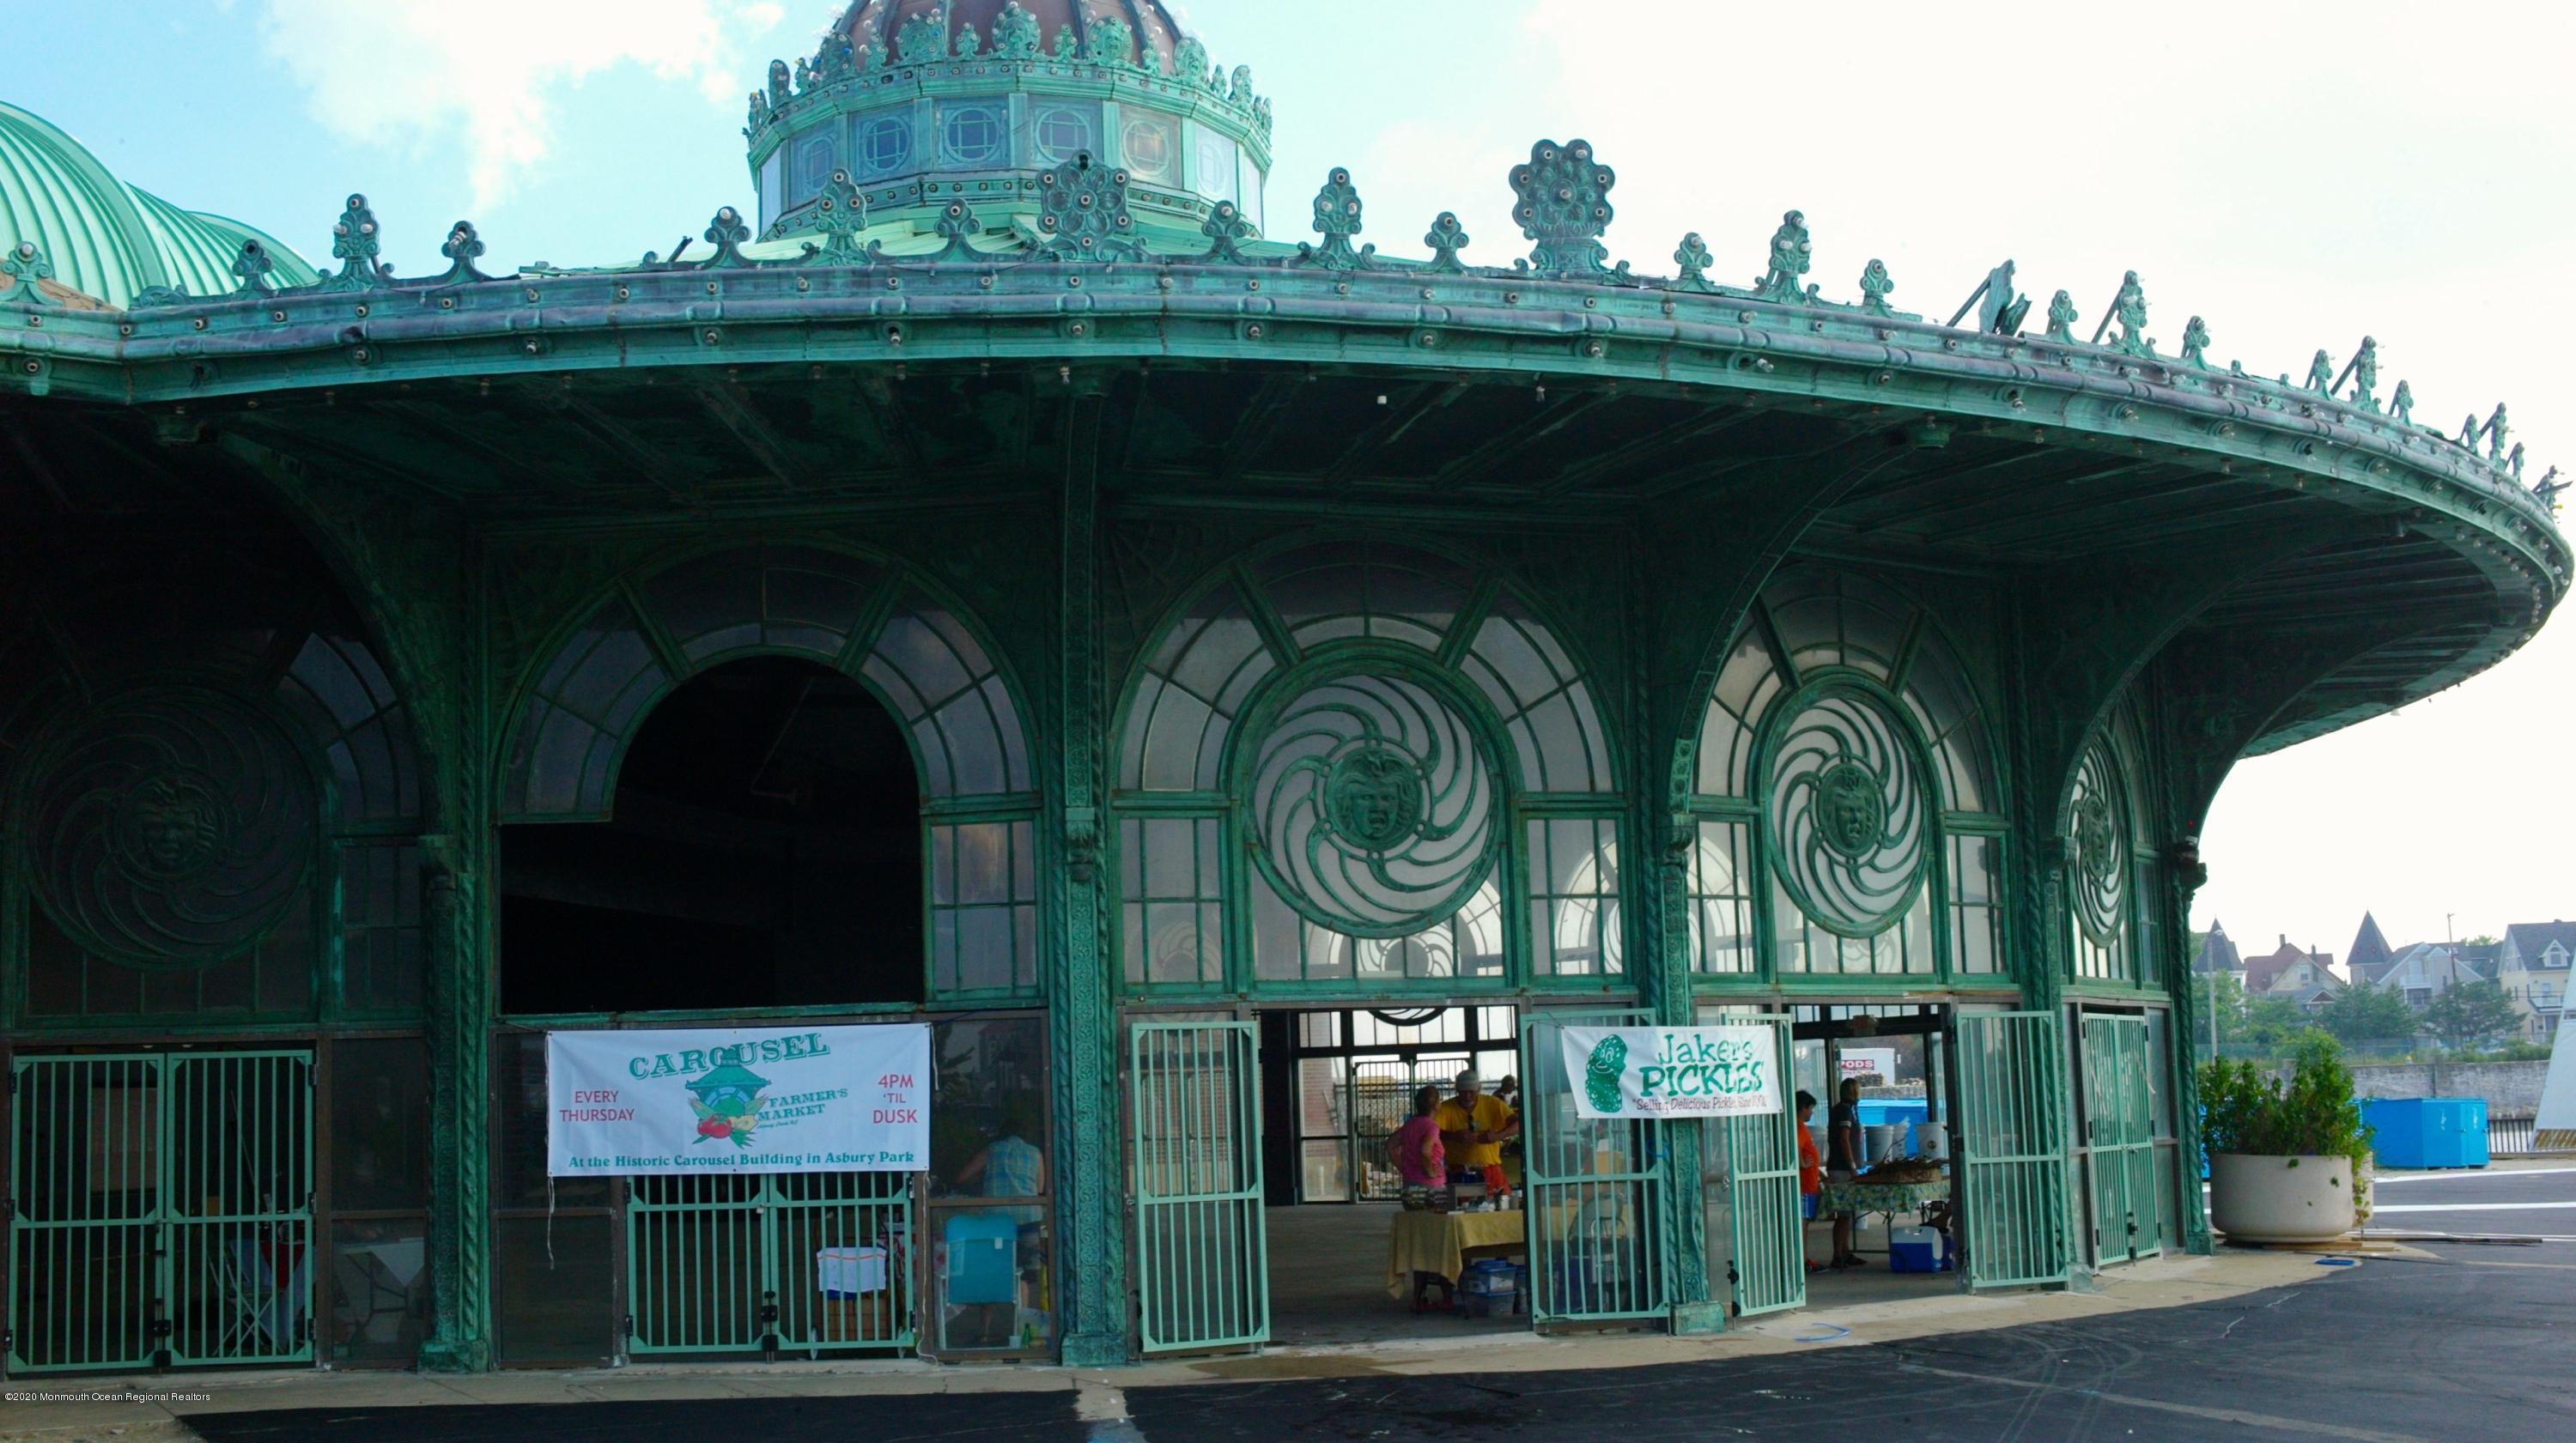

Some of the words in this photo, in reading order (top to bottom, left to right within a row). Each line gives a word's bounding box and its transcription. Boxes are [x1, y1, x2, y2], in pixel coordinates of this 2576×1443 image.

[629, 1033, 830, 1080] CAROUSEL
[878, 1074, 914, 1088] 4PM
[1639, 1061, 1764, 1097] PICKLES
[574, 1090, 619, 1104] EVERY
[883, 1093, 907, 1104] 'TIL
[1671, 1098, 1710, 1110] Delicious
[559, 1108, 635, 1122] THURSDAY
[757, 1103, 825, 1122] MARKET
[873, 1109, 918, 1124] DUSK
[568, 1156, 584, 1167] At
[588, 1156, 611, 1167] the
[615, 1155, 670, 1167] Historic
[673, 1155, 736, 1167] Carousel
[740, 1154, 802, 1166] Building
[807, 1153, 821, 1164] in
[824, 1152, 875, 1165] Asbury
[879, 1151, 914, 1163] Park
